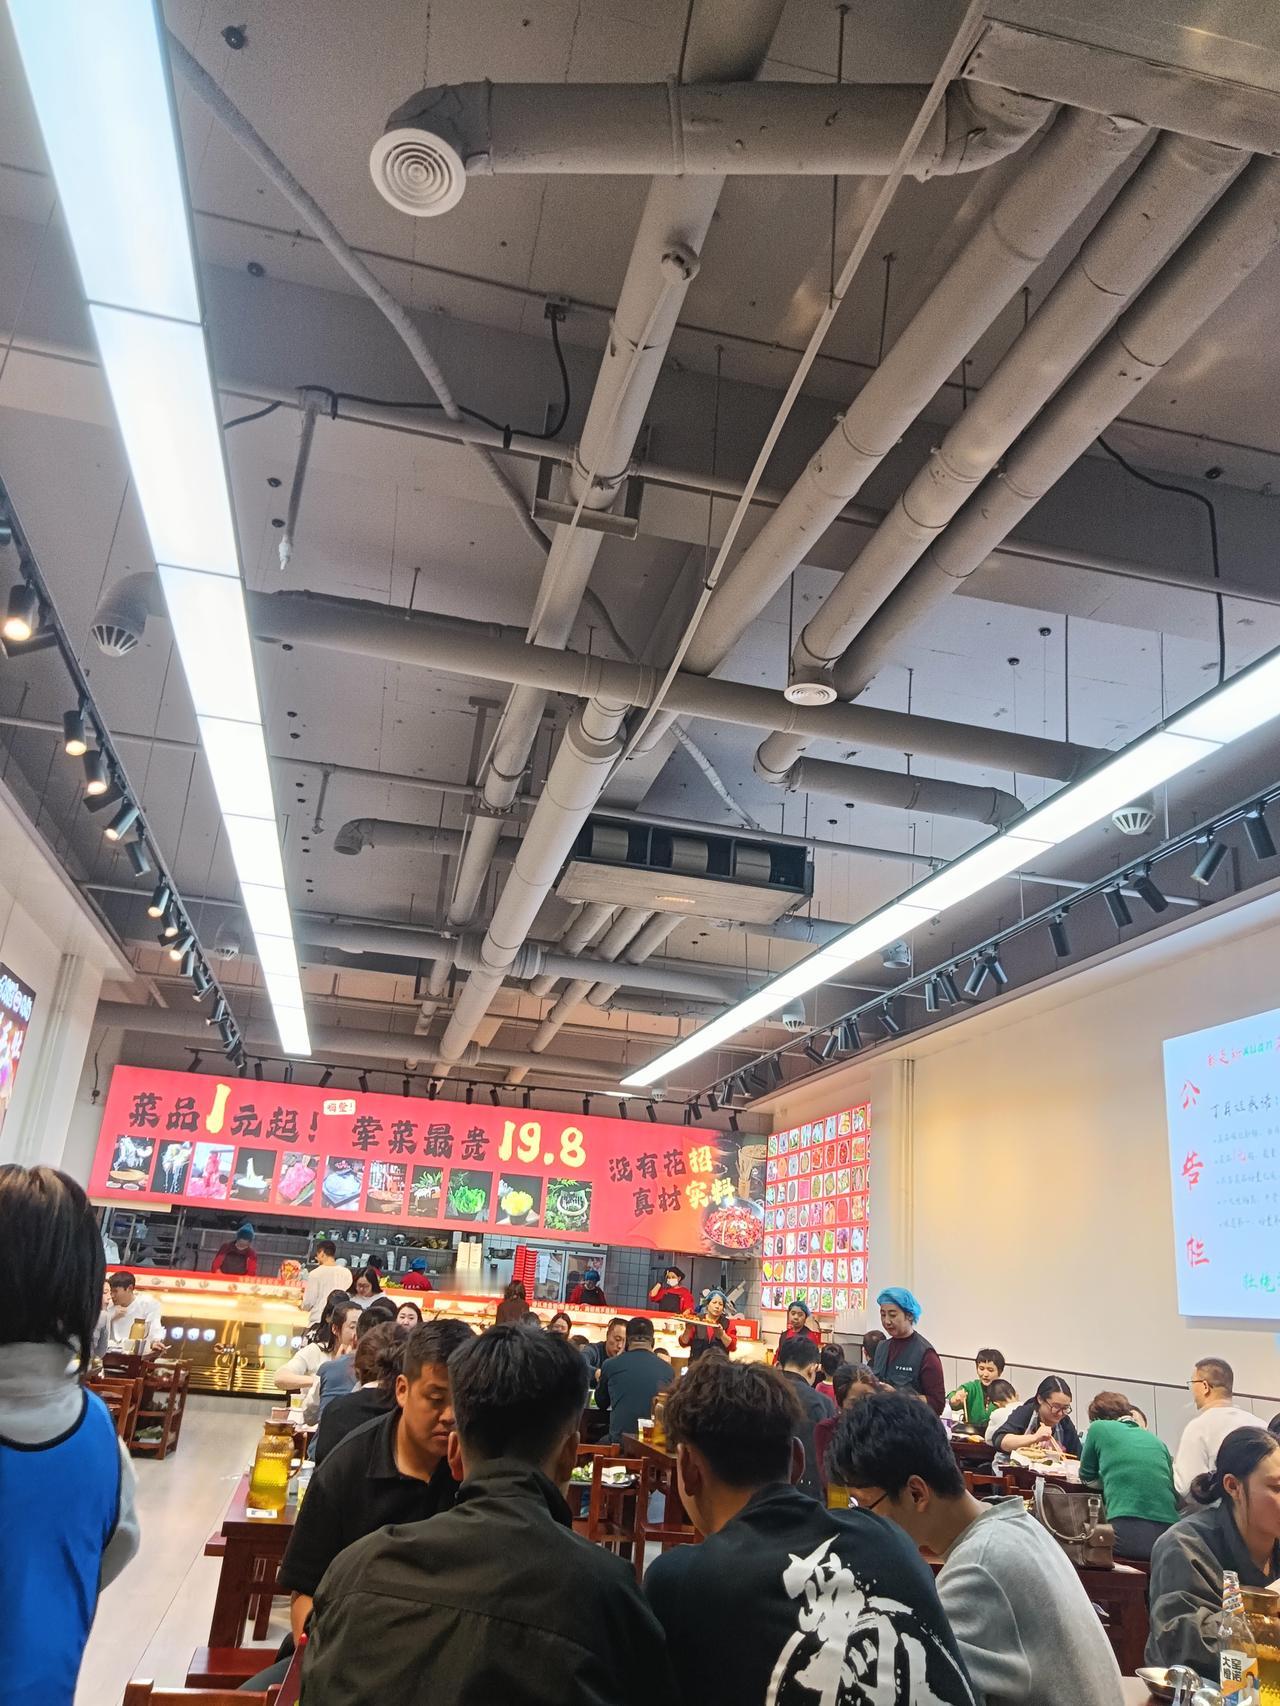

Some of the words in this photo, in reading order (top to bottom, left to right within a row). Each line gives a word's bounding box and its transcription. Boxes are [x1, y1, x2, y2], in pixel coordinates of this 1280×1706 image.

[129, 1083, 319, 1143] 菜品1元起!
[352, 1116, 587, 1168] 荤菜最贵19.8
[608, 1145, 714, 1183] 没有花招
[632, 1177, 737, 1218] 真材实料
